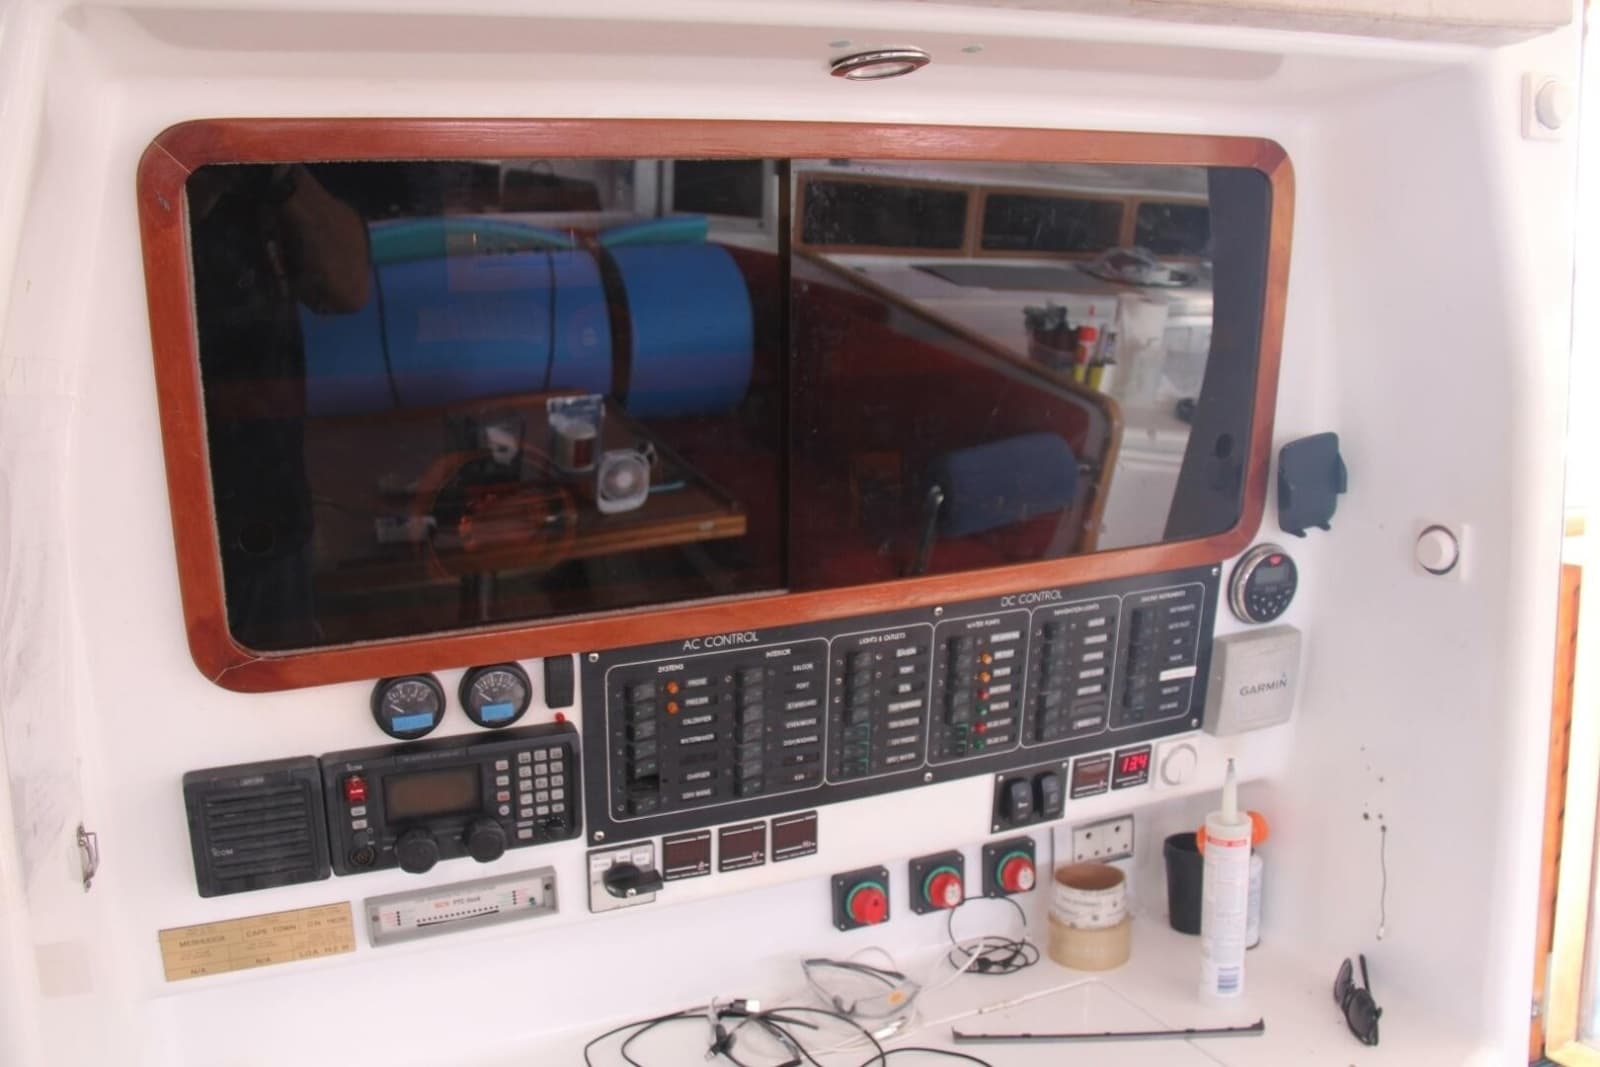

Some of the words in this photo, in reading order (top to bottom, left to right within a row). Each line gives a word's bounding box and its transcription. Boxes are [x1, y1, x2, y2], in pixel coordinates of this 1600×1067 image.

[1000, 595, 1017, 608] DC
[1019, 588, 1063, 605] CONTROL
[683, 640, 701, 651] AC
[704, 632, 760, 649] CONTROL
[1239, 678, 1288, 697] GARMIN
